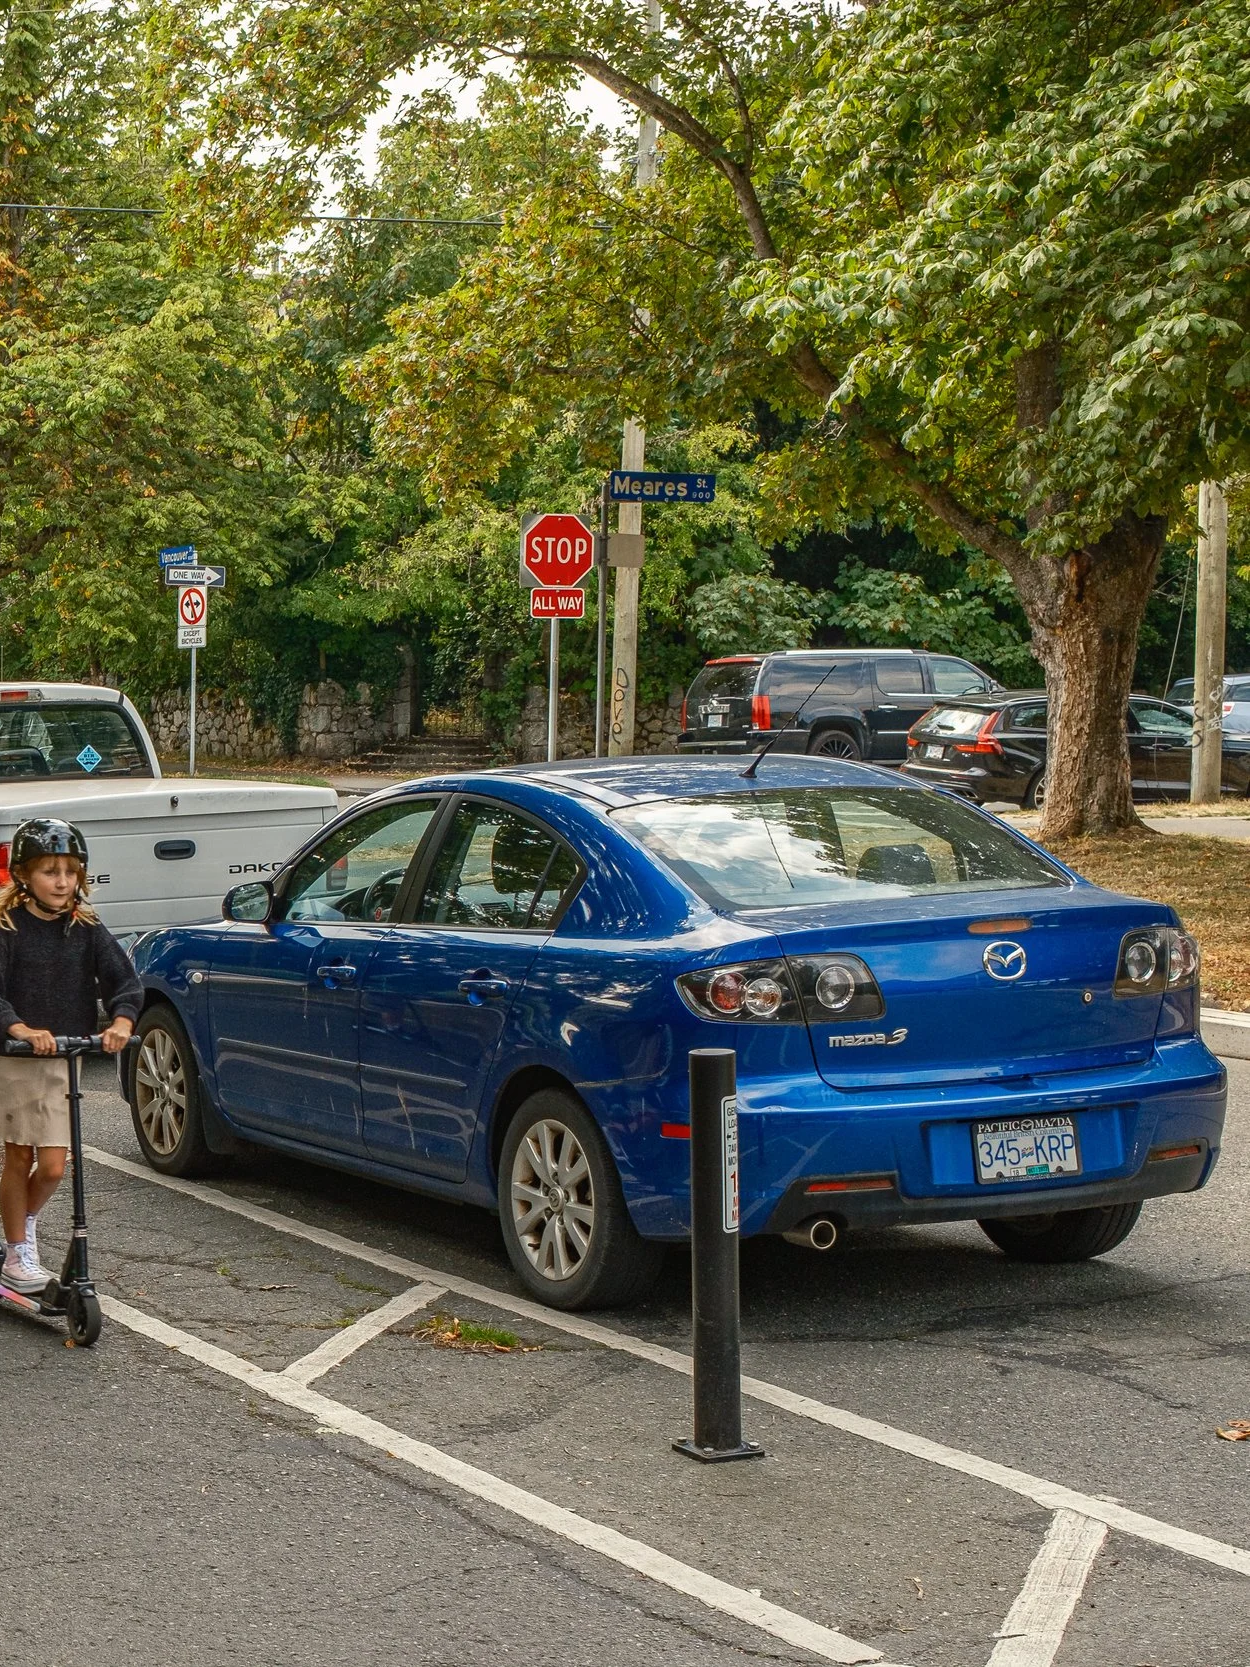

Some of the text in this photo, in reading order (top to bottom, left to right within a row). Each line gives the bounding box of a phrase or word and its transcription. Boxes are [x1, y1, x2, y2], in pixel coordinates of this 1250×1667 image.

[613, 475, 709, 497] Meares St.
[692, 491, 711, 499] 900
[161, 550, 189, 564] Vancouver
[530, 536, 587, 564] STOP
[173, 571, 205, 580] ONE WAY
[533, 596, 582, 610] ALL WAY
[181, 637, 203, 645] BICYCLES
[978, 1117, 1074, 1133] PACIFIC MAZDA
[979, 1133, 1075, 1168] 345 KRP
